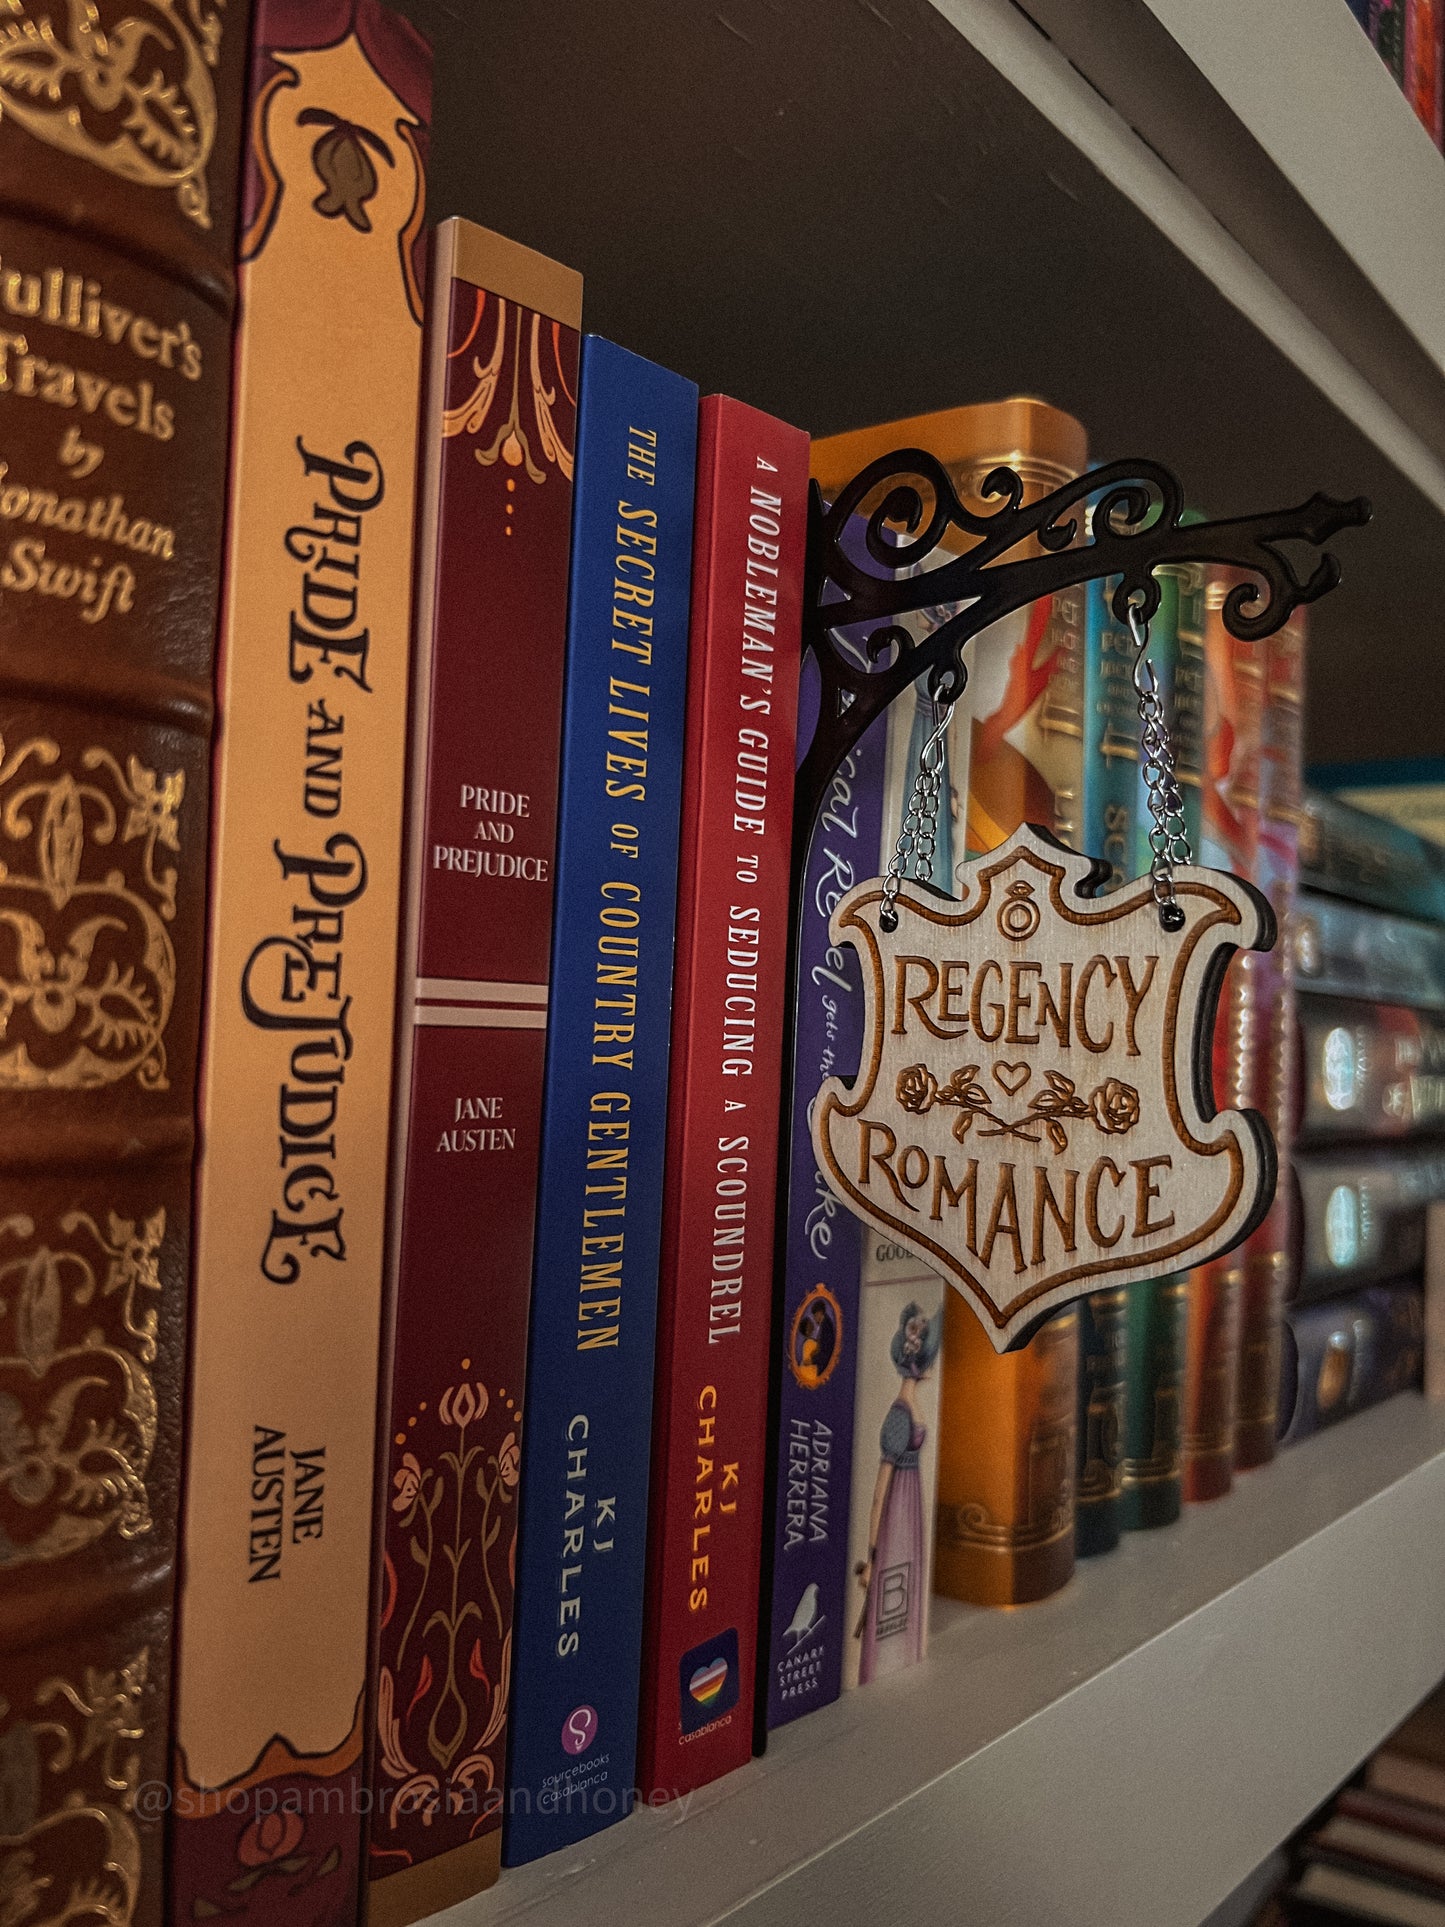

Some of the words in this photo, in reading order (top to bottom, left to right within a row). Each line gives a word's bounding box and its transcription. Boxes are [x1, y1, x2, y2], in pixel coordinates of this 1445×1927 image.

[0, 267, 201, 381] ulliver's
[59, 425, 104, 479] by
[627, 425, 657, 486] THE
[756, 455, 778, 474] A
[0, 465, 175, 561] onathan
[0, 538, 136, 624] Swift
[284, 435, 385, 692] PRIDE
[611, 500, 659, 665] SECRET
[738, 486, 782, 715] NOBLEMAN'S
[305, 698, 345, 819] AND
[606, 677, 651, 801] LIVES
[734, 727, 771, 836] GUIDE
[460, 784, 530, 818] PRIDE
[473, 820, 515, 844] AND
[610, 823, 639, 859] OF
[433, 844, 549, 882] PREJUDICE
[735, 854, 759, 884] TO
[592, 881, 641, 1071] COUNTRY
[721, 905, 760, 1077] SEDUCING
[890, 954, 1159, 1056] REGENCY
[241, 832, 369, 1285] PREJUDICE
[724, 1099, 746, 1113] A
[436, 1127, 516, 1152] AUSTEN
[454, 1096, 504, 1123] JANE
[576, 1091, 632, 1352] GENTLEMEN
[708, 1136, 749, 1345] SCOUNDREL
[857, 1118, 1177, 1275] ROMANCE
[247, 1424, 287, 1584] AUSTEN
[291, 1445, 327, 1545] JANE
[689, 1384, 718, 1612] CHARLES
[783, 1418, 811, 1552] HERRERA
[808, 1419, 833, 1543] ADRIANA
[556, 1413, 590, 1658] CHARLES
[777, 1646, 825, 1673] CANARY
[779, 1661, 822, 1687] STREET
[781, 1677, 819, 1700] PRESS
[541, 1752, 610, 1788] sourcebooks
[678, 1715, 733, 1745] casablanca
[541, 1771, 609, 1806] casablanca
